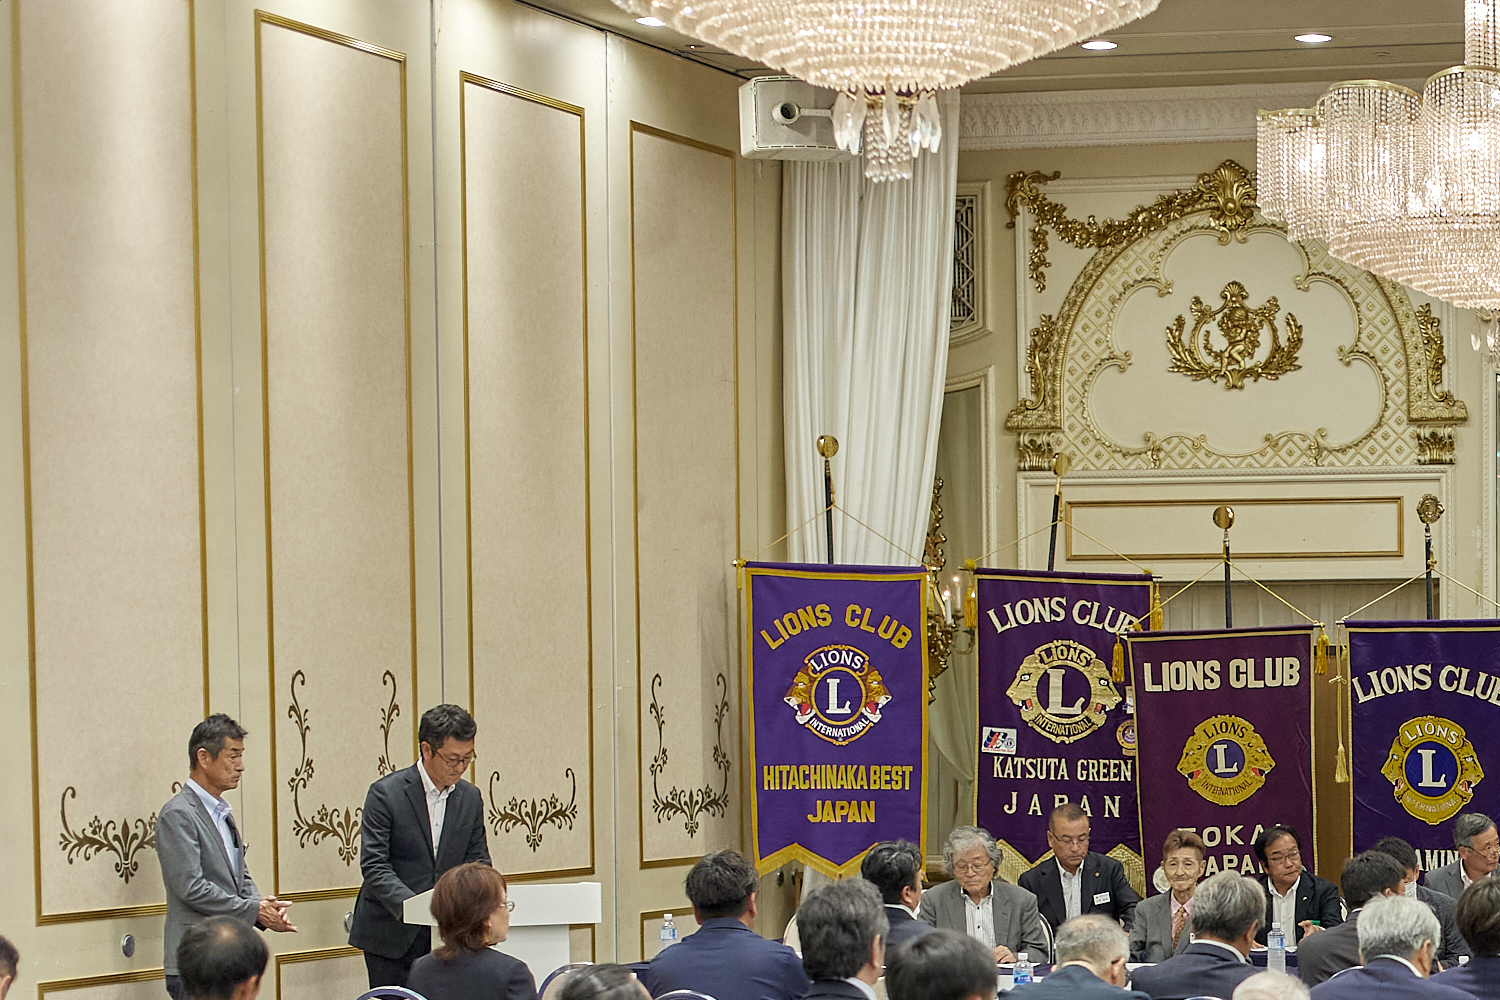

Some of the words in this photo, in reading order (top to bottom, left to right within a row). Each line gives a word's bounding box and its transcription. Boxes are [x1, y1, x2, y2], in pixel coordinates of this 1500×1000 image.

[760, 603, 833, 650] LIONS
[844, 603, 913, 649] CLUB
[986, 596, 1067, 634] LIONS
[809, 650, 864, 672] LIONS
[1040, 645, 1092, 667] LIONS
[1143, 659, 1221, 692] LIONS
[1228, 656, 1301, 689] CLUB
[1351, 663, 1433, 704] LIONS
[825, 678, 852, 714] L
[1045, 668, 1086, 715] L
[809, 717, 870, 738] INTERNATIONAL
[1034, 714, 1092, 736] INTERNATIONAL
[1202, 721, 1248, 740] LIONS
[1404, 722, 1459, 744] LIONS
[992, 755, 1070, 781] KATSUTA
[1076, 758, 1133, 782] GREEN
[1213, 744, 1239, 774] L
[1417, 749, 1447, 788] L
[763, 764, 868, 791] HITACHINAKA
[869, 764, 914, 791] BEST
[1200, 779, 1254, 796] INTERNATIONAL
[806, 799, 876, 823] JAPAN
[1403, 793, 1461, 813] INTERNATIONAL
